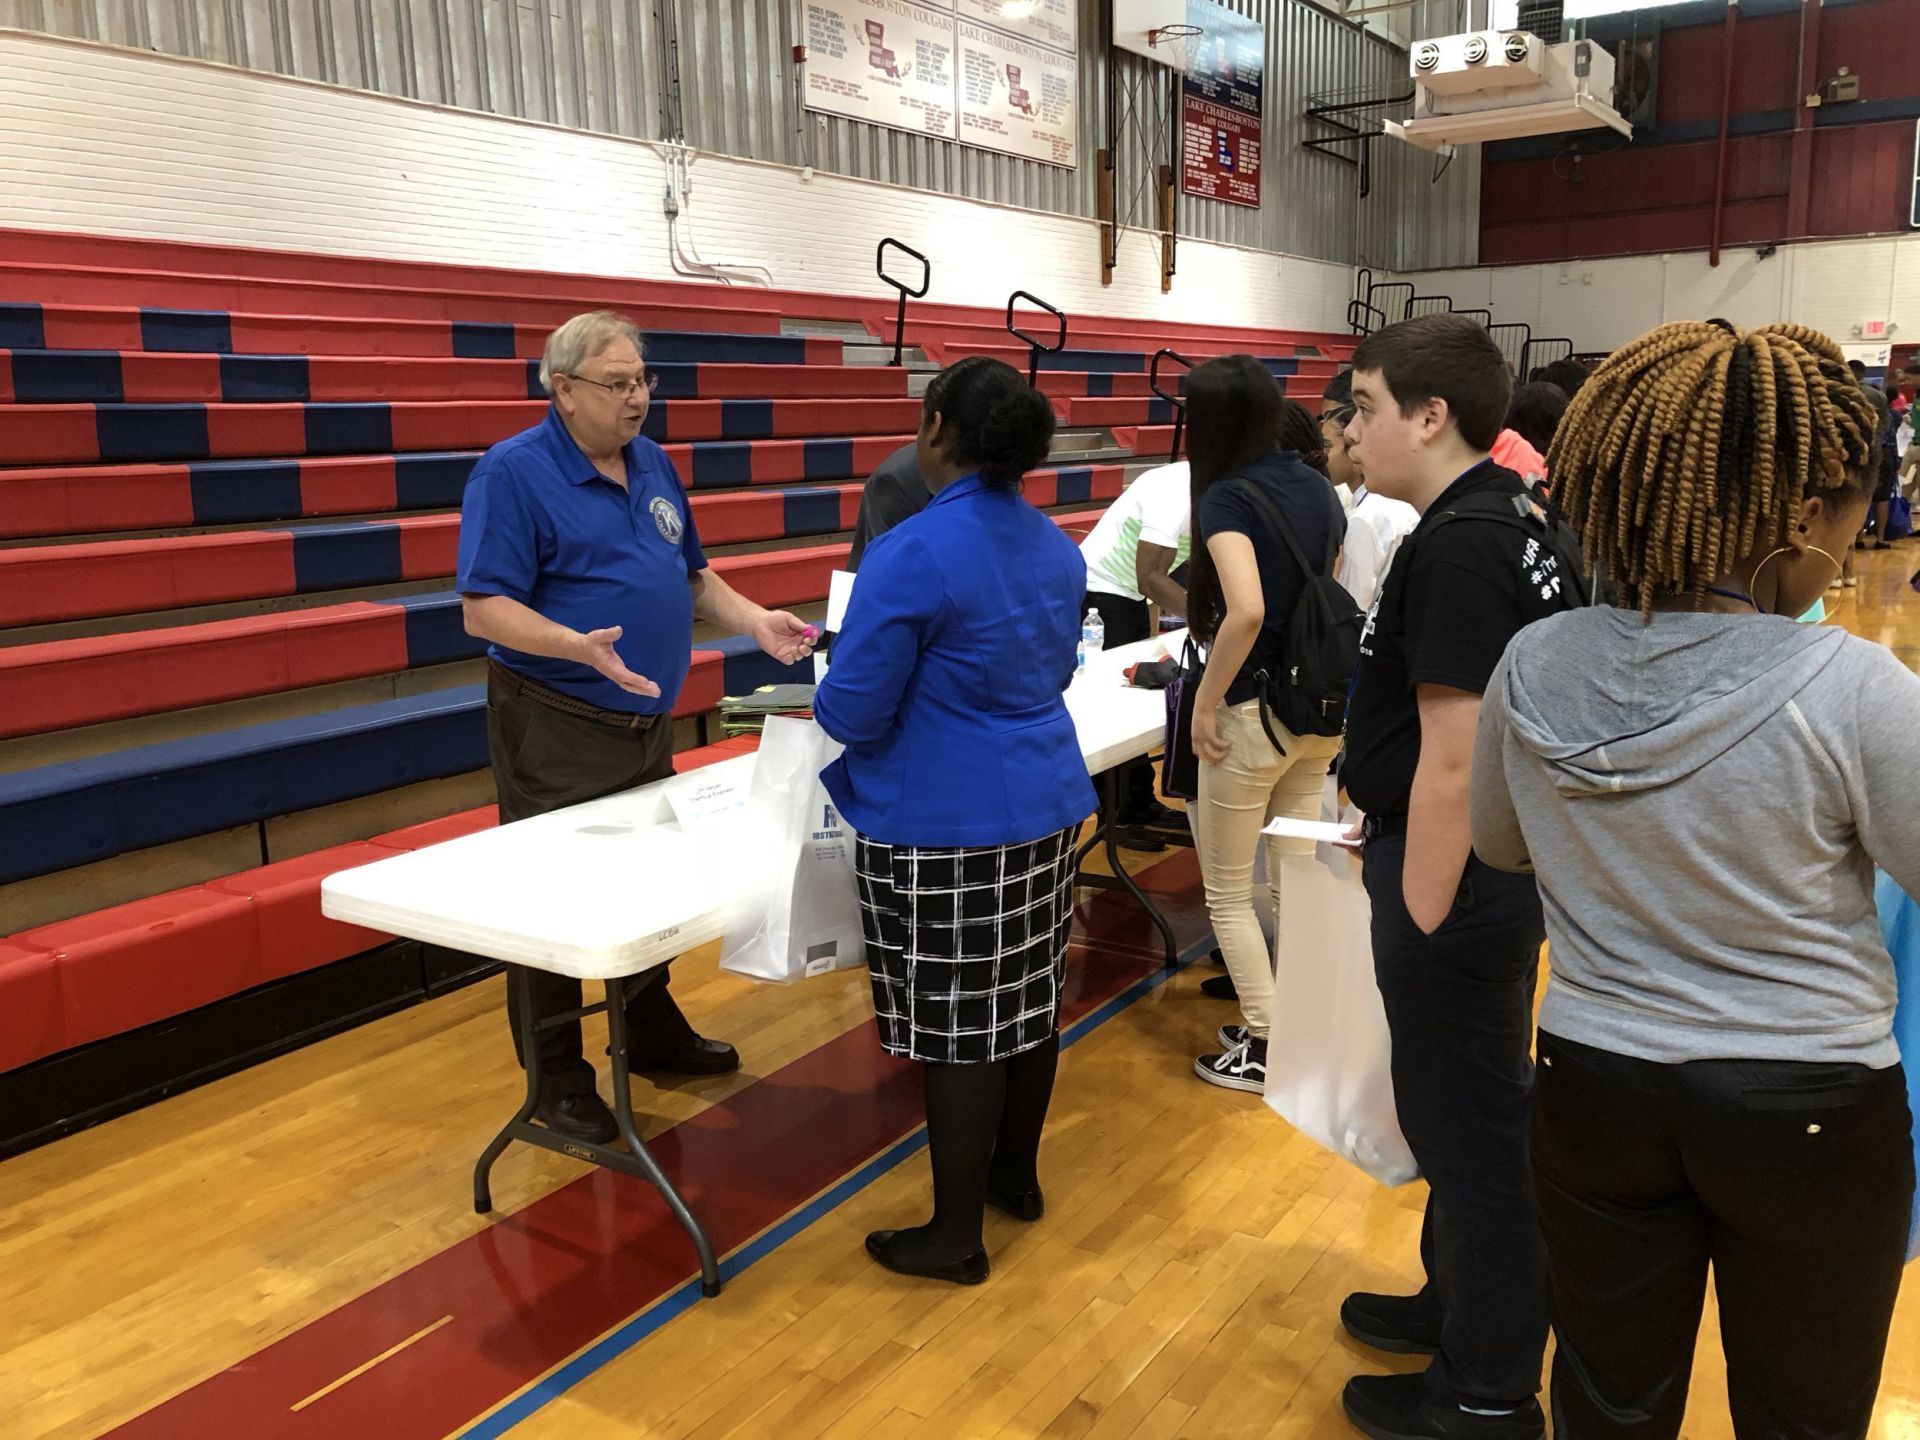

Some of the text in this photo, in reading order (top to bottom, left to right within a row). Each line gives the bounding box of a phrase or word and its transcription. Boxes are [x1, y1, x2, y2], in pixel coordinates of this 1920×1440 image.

[914, 8, 953, 32] COUGARS
[959, 23, 980, 41] LAKE
[1186, 98, 1204, 113] LAKE
[1202, 115, 1241, 133] LADY COUGARS
